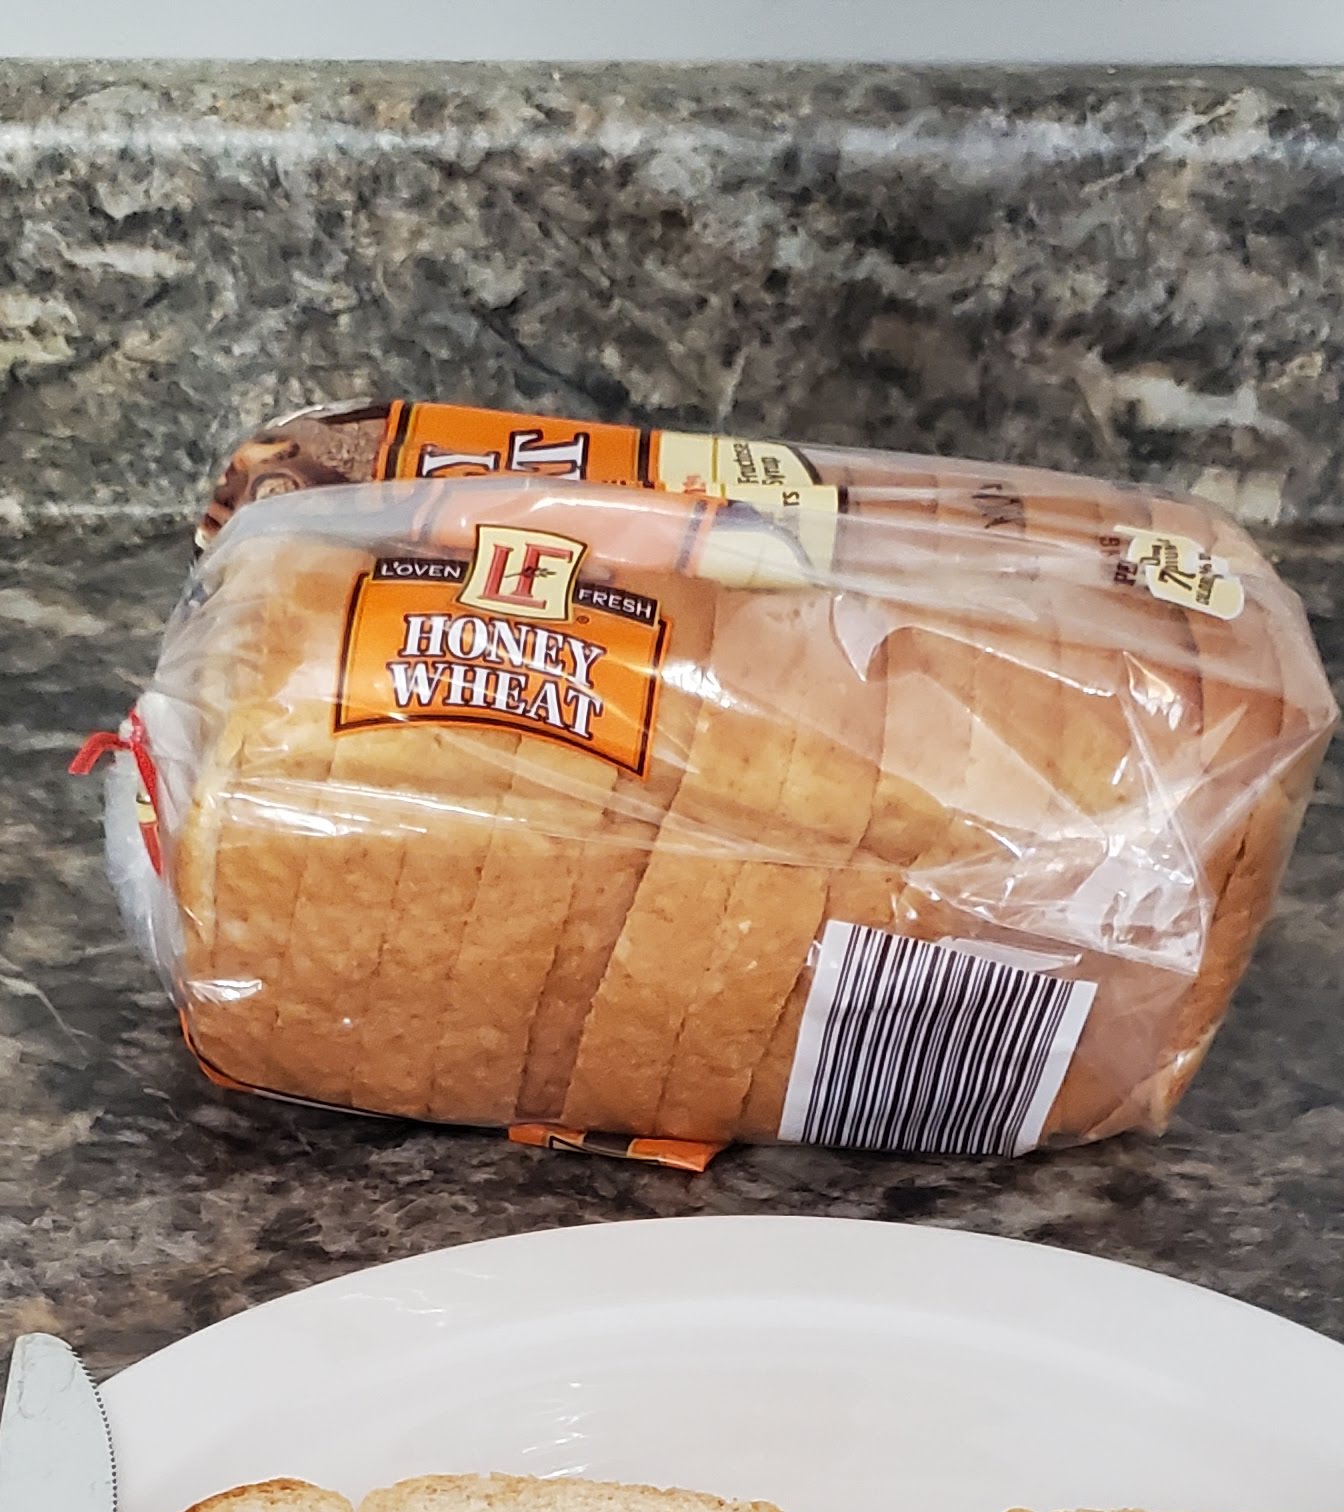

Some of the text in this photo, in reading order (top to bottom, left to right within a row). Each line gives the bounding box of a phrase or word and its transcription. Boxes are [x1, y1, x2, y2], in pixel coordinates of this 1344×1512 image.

[381, 561, 461, 578] L'OVEN
[577, 589, 652, 618] FRESH
[400, 613, 606, 688] HONEY
[387, 662, 603, 738] WHEAT
